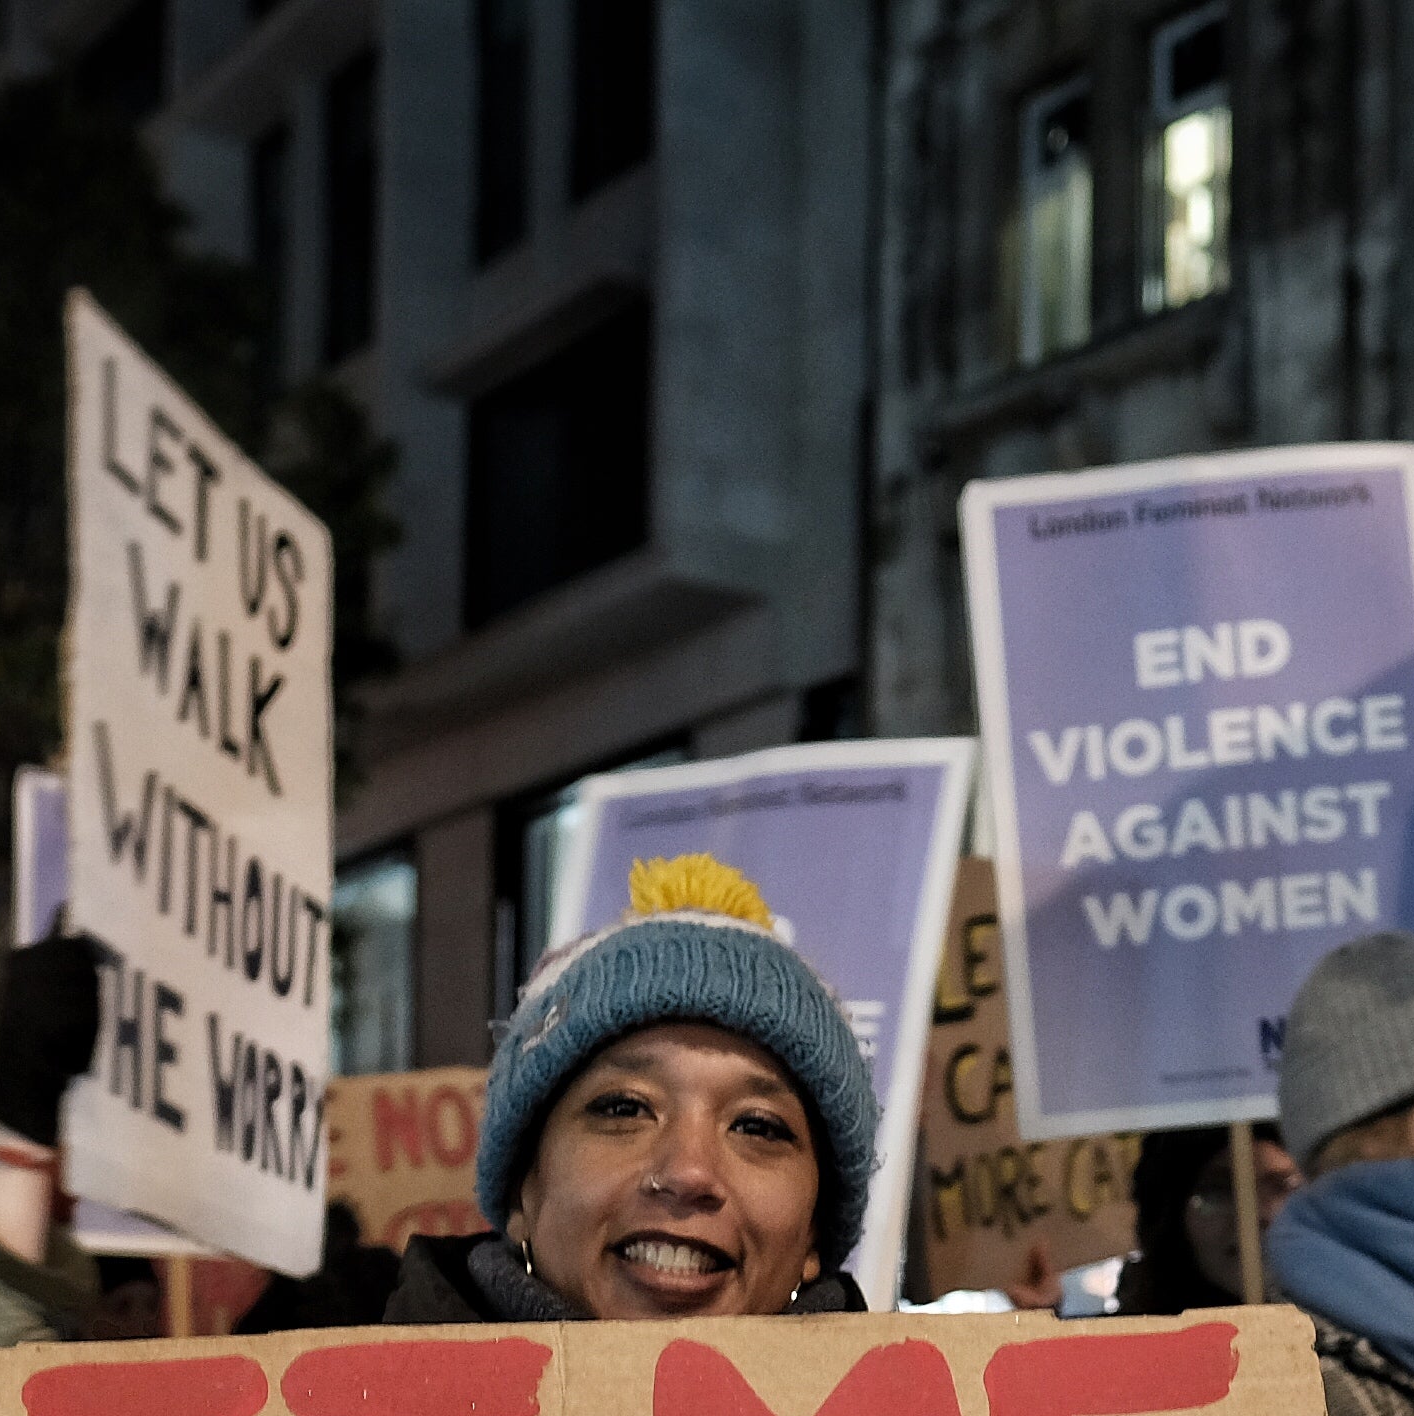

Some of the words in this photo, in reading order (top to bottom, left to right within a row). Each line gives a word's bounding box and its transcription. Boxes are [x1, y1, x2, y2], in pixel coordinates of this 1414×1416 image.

[101, 356, 220, 562] LET
[238, 499, 305, 650] US
[127, 540, 283, 798] WALK
[1133, 618, 1292, 690] END
[1028, 693, 1409, 786] VIOLENCE
[91, 719, 327, 1007] WITHOUT
[1059, 781, 1392, 868] AGAINST
[1085, 868, 1380, 951] WOMEN
